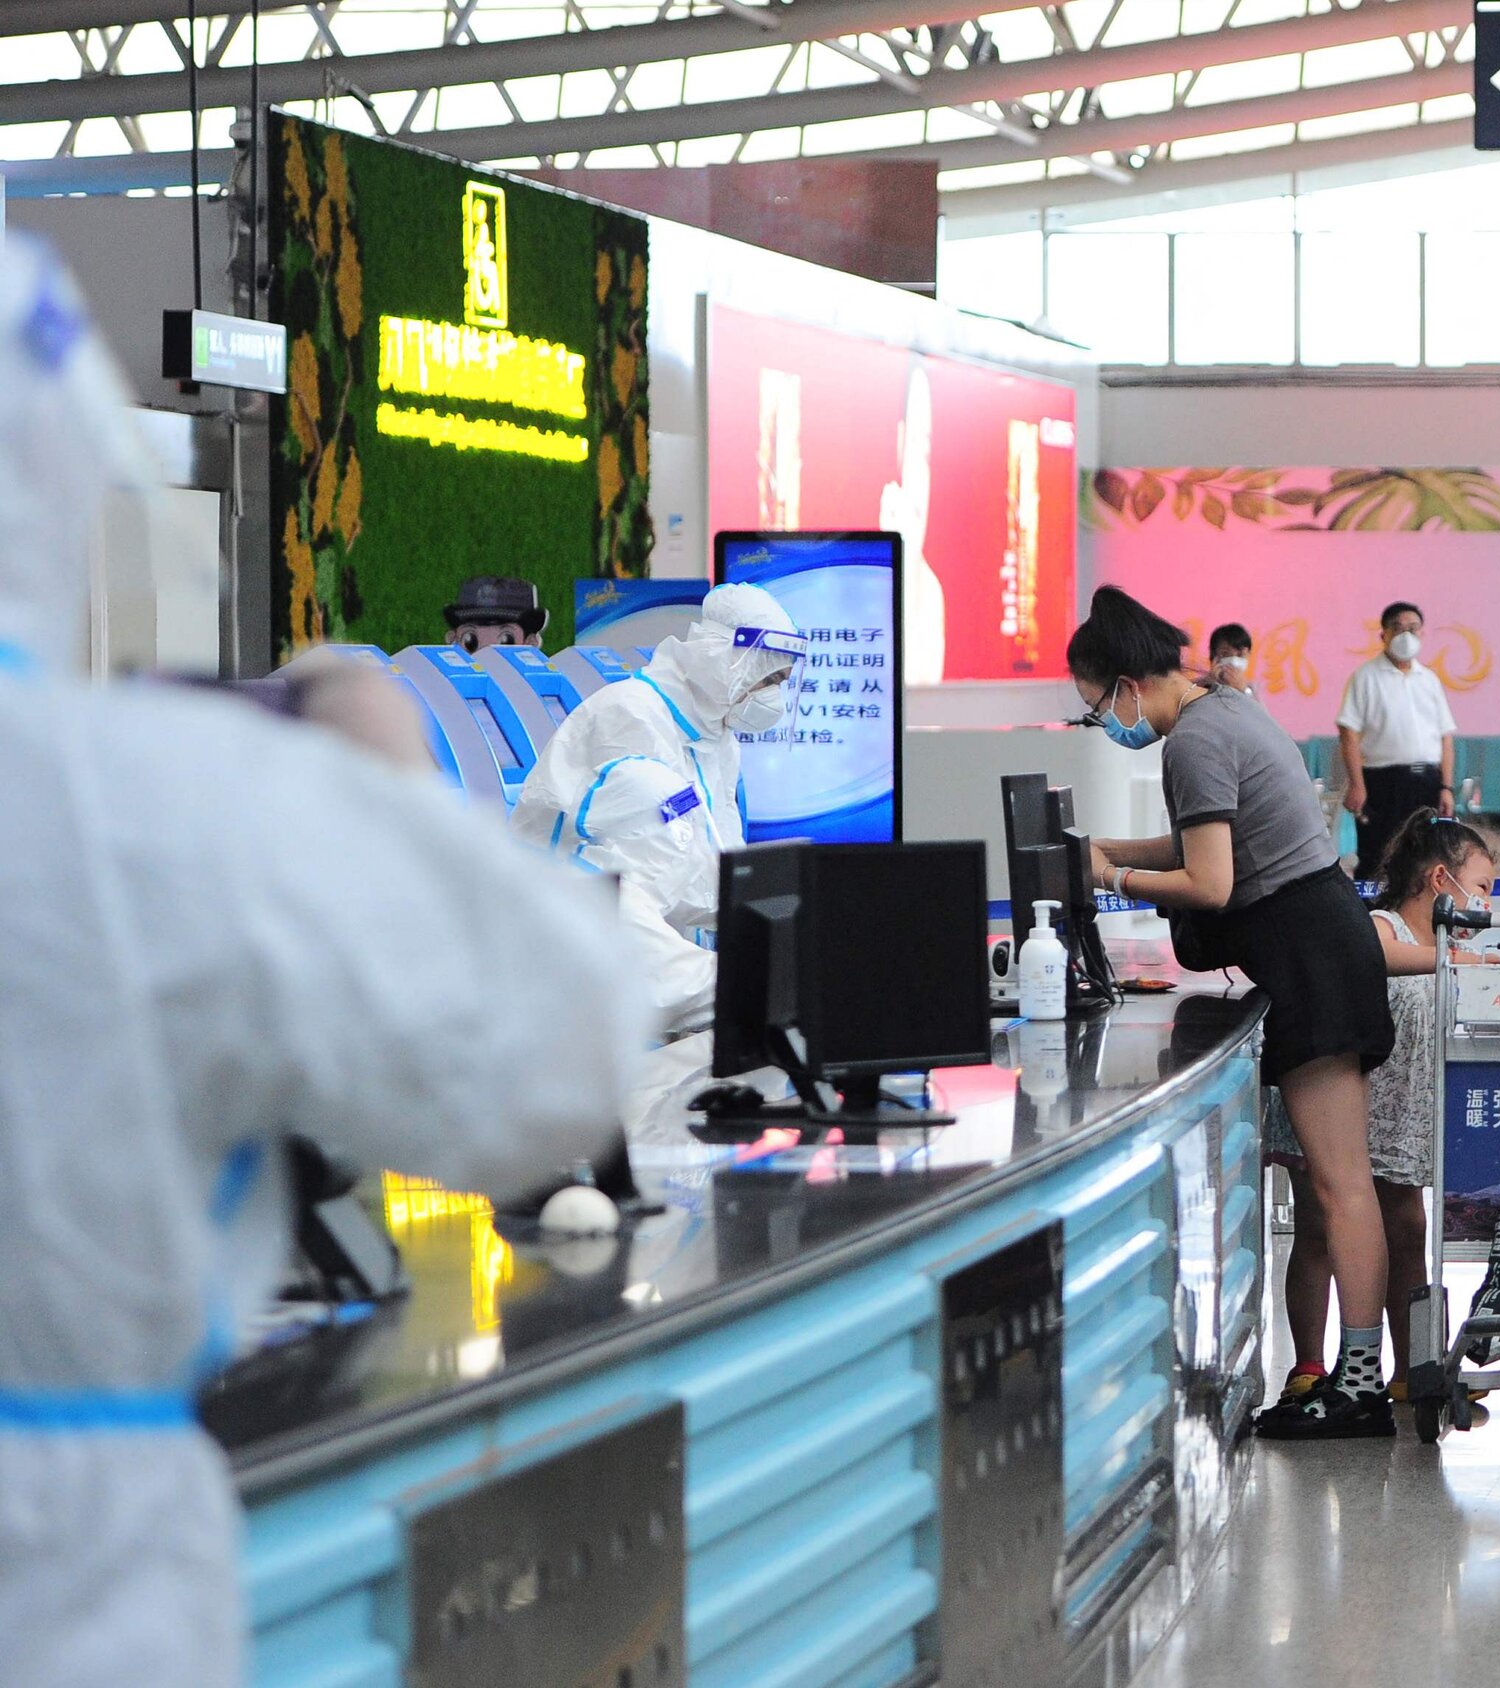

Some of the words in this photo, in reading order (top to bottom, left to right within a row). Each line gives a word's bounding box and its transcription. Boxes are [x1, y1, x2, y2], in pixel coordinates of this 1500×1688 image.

[802, 653, 885, 668] 机证明
[1466, 1088, 1483, 1128] 温暖
